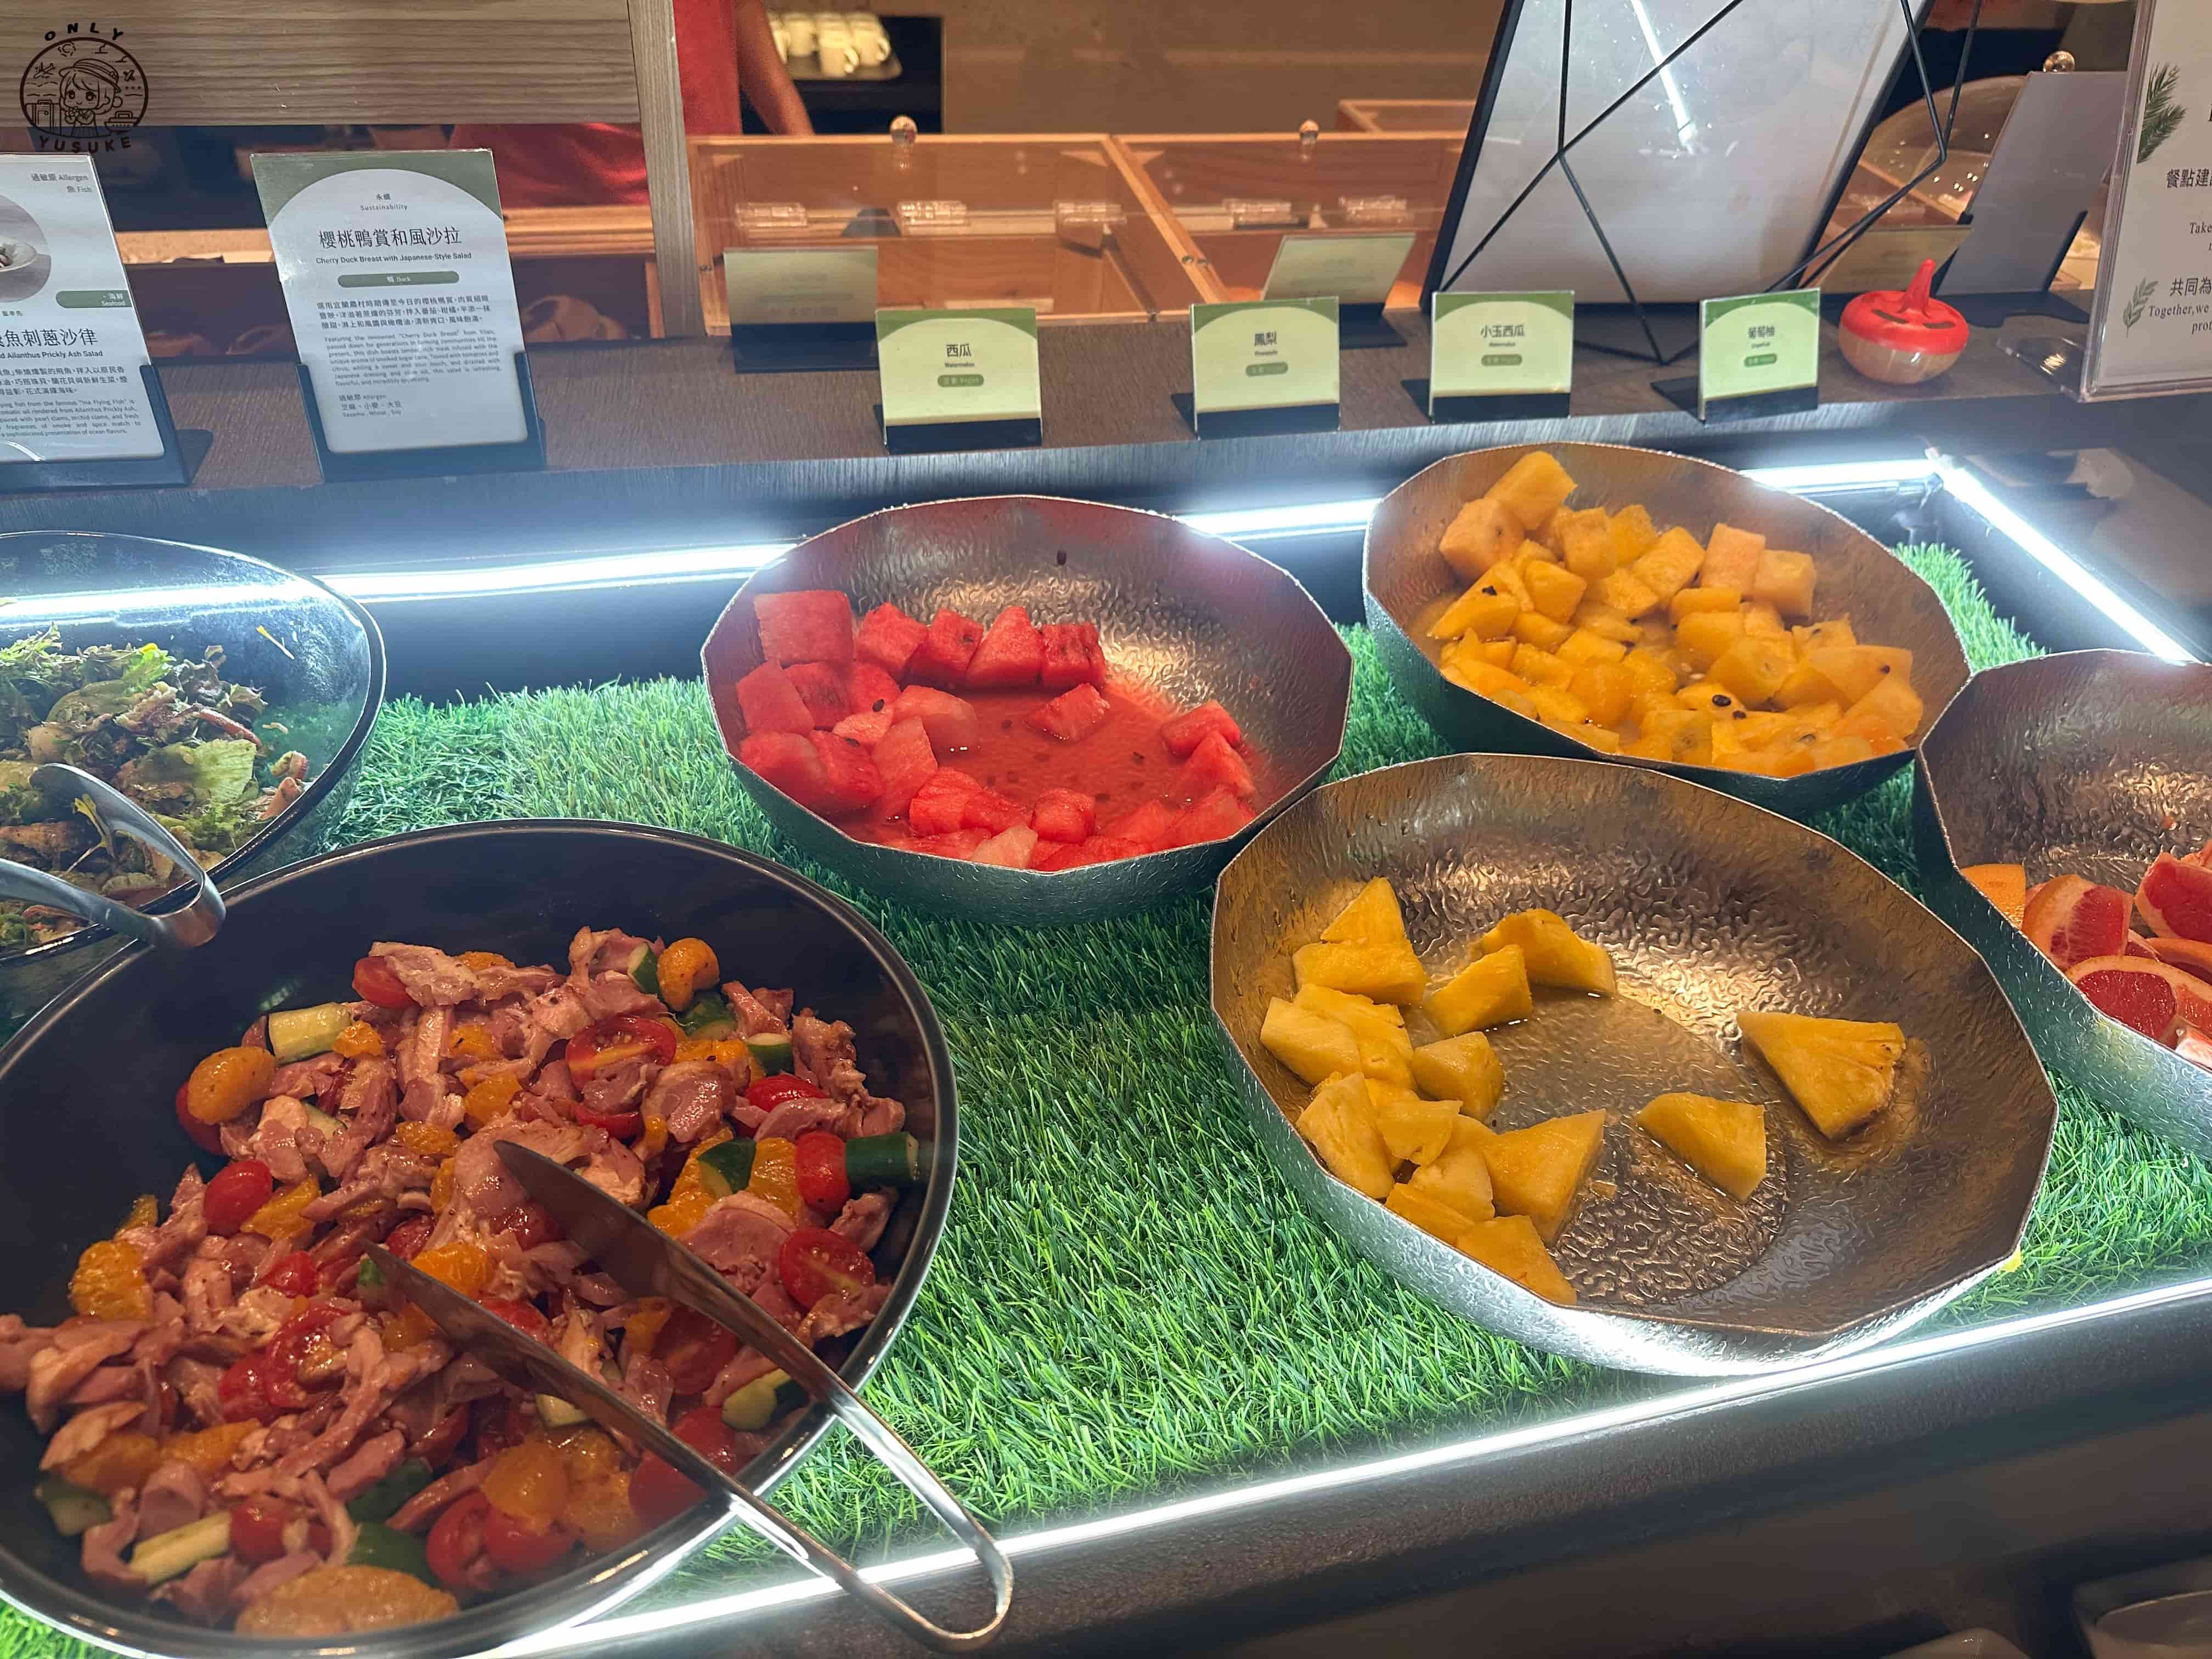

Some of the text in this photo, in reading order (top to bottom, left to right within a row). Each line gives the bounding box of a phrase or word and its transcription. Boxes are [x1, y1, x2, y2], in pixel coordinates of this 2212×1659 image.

[2166, 167, 2212, 189] 餐點建
[318, 226, 462, 249] 櫻桃鴨賞和風沙拉
[316, 257, 338, 265] Cherry
[0, 328, 98, 347] 魚刺蔥沙律
[1480, 324, 1525, 338] 小玉西瓜
[1747, 325, 1776, 339] 葡萄柚
[1254, 331, 1278, 347] 鳳梨
[946, 343, 972, 357] 西瓜
